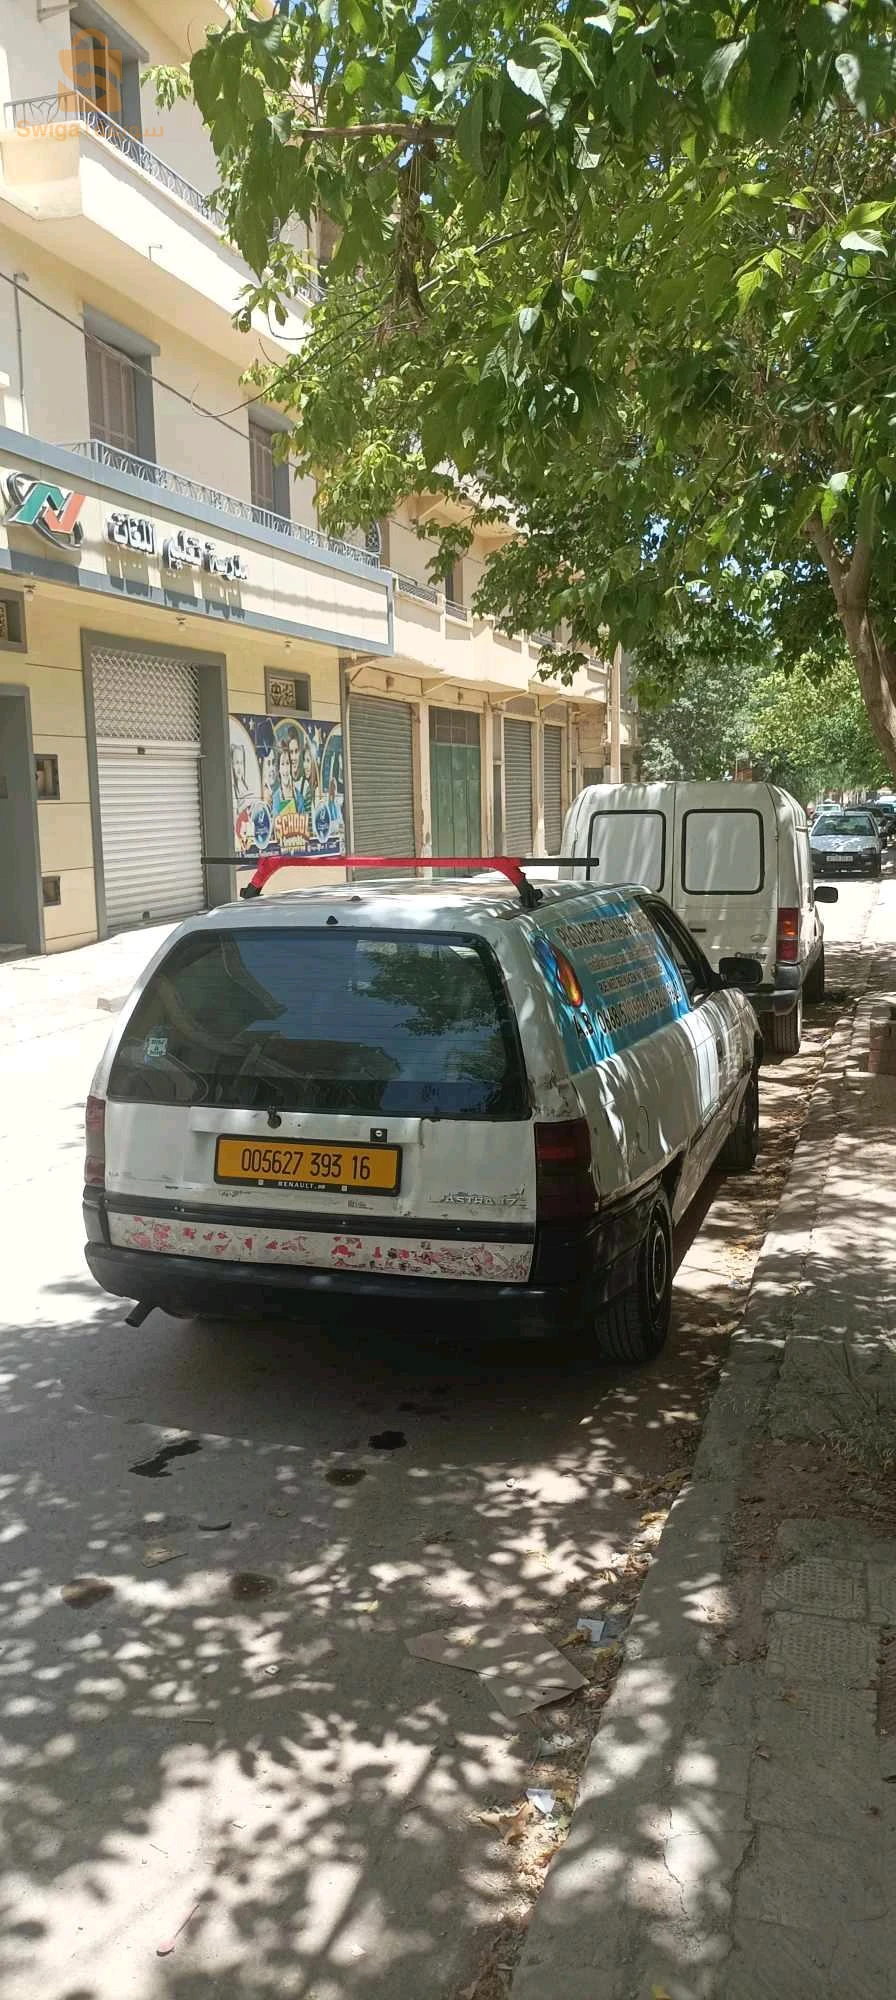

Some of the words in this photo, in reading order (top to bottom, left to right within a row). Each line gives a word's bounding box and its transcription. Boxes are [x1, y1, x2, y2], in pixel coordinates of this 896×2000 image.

[107, 512, 154, 554] اللغات
[163, 530, 202, 570] تعليم
[203, 542, 248, 581] مدرسة
[275, 814, 310, 837] SCHOOL
[241, 1148, 303, 1175] 005627
[310, 1152, 343, 1178] 393
[352, 1155, 371, 1181] 16
